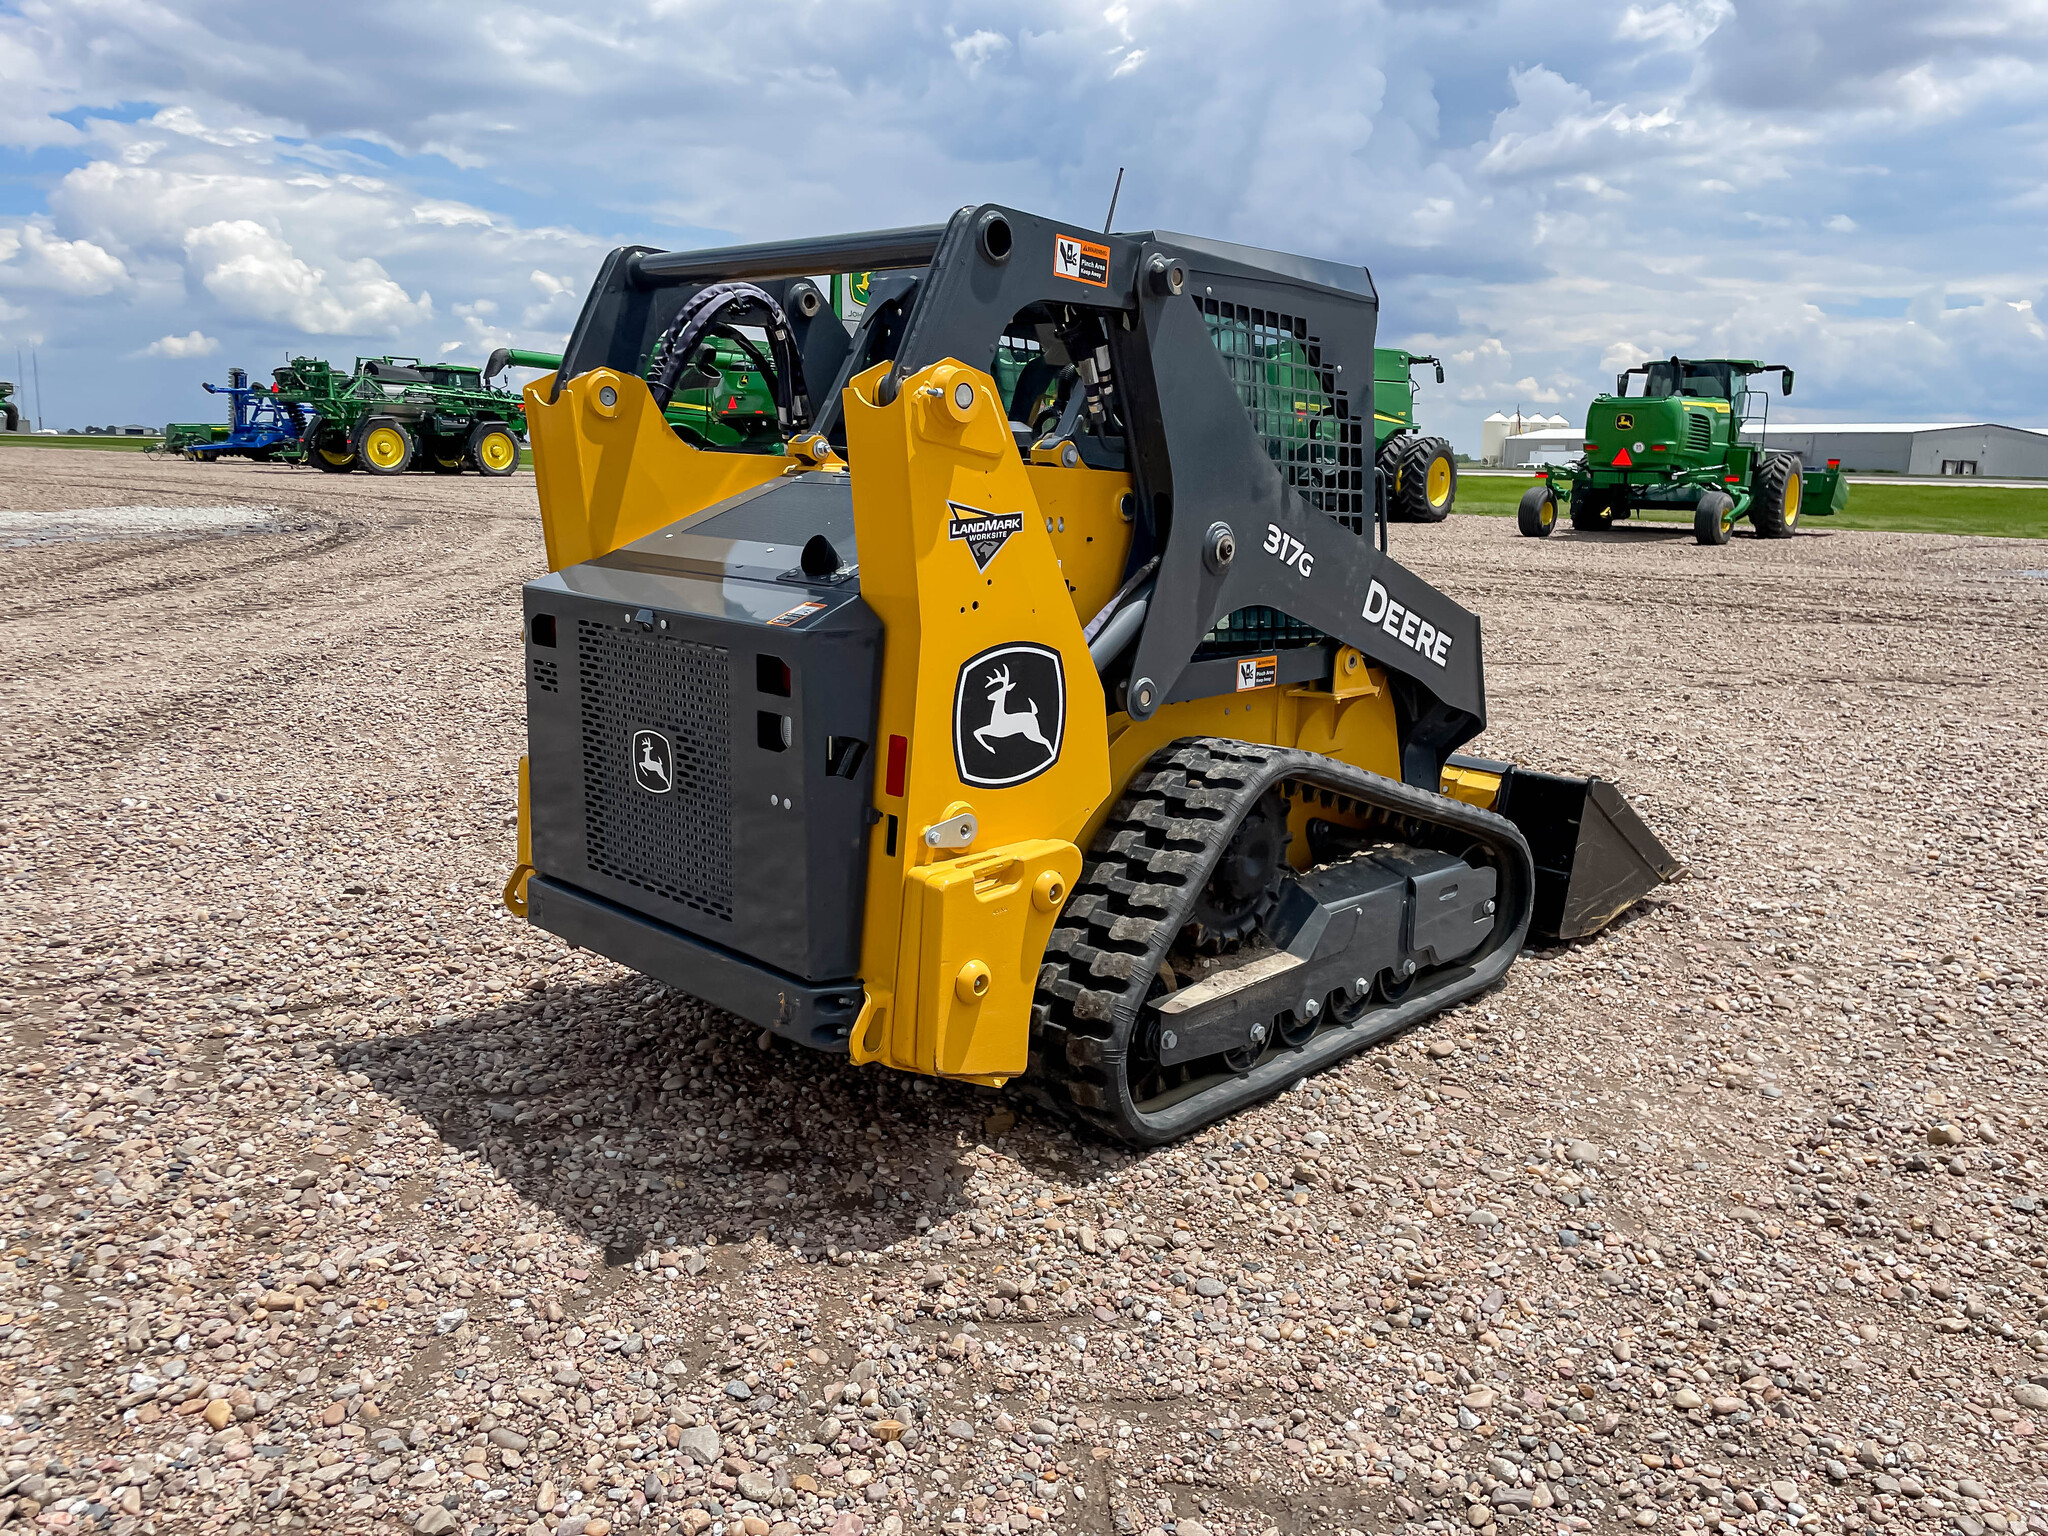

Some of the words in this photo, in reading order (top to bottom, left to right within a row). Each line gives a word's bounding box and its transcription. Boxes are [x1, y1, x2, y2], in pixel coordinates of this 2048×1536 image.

[1081, 259, 1094, 268] Pinch
[1095, 262, 1106, 271] Area
[1080, 268, 1090, 276] Keep
[1091, 270, 1102, 279] Away
[969, 530, 1007, 542] WORKSITE
[1262, 523, 1315, 578] 317G
[1361, 578, 1453, 668] DEERE
